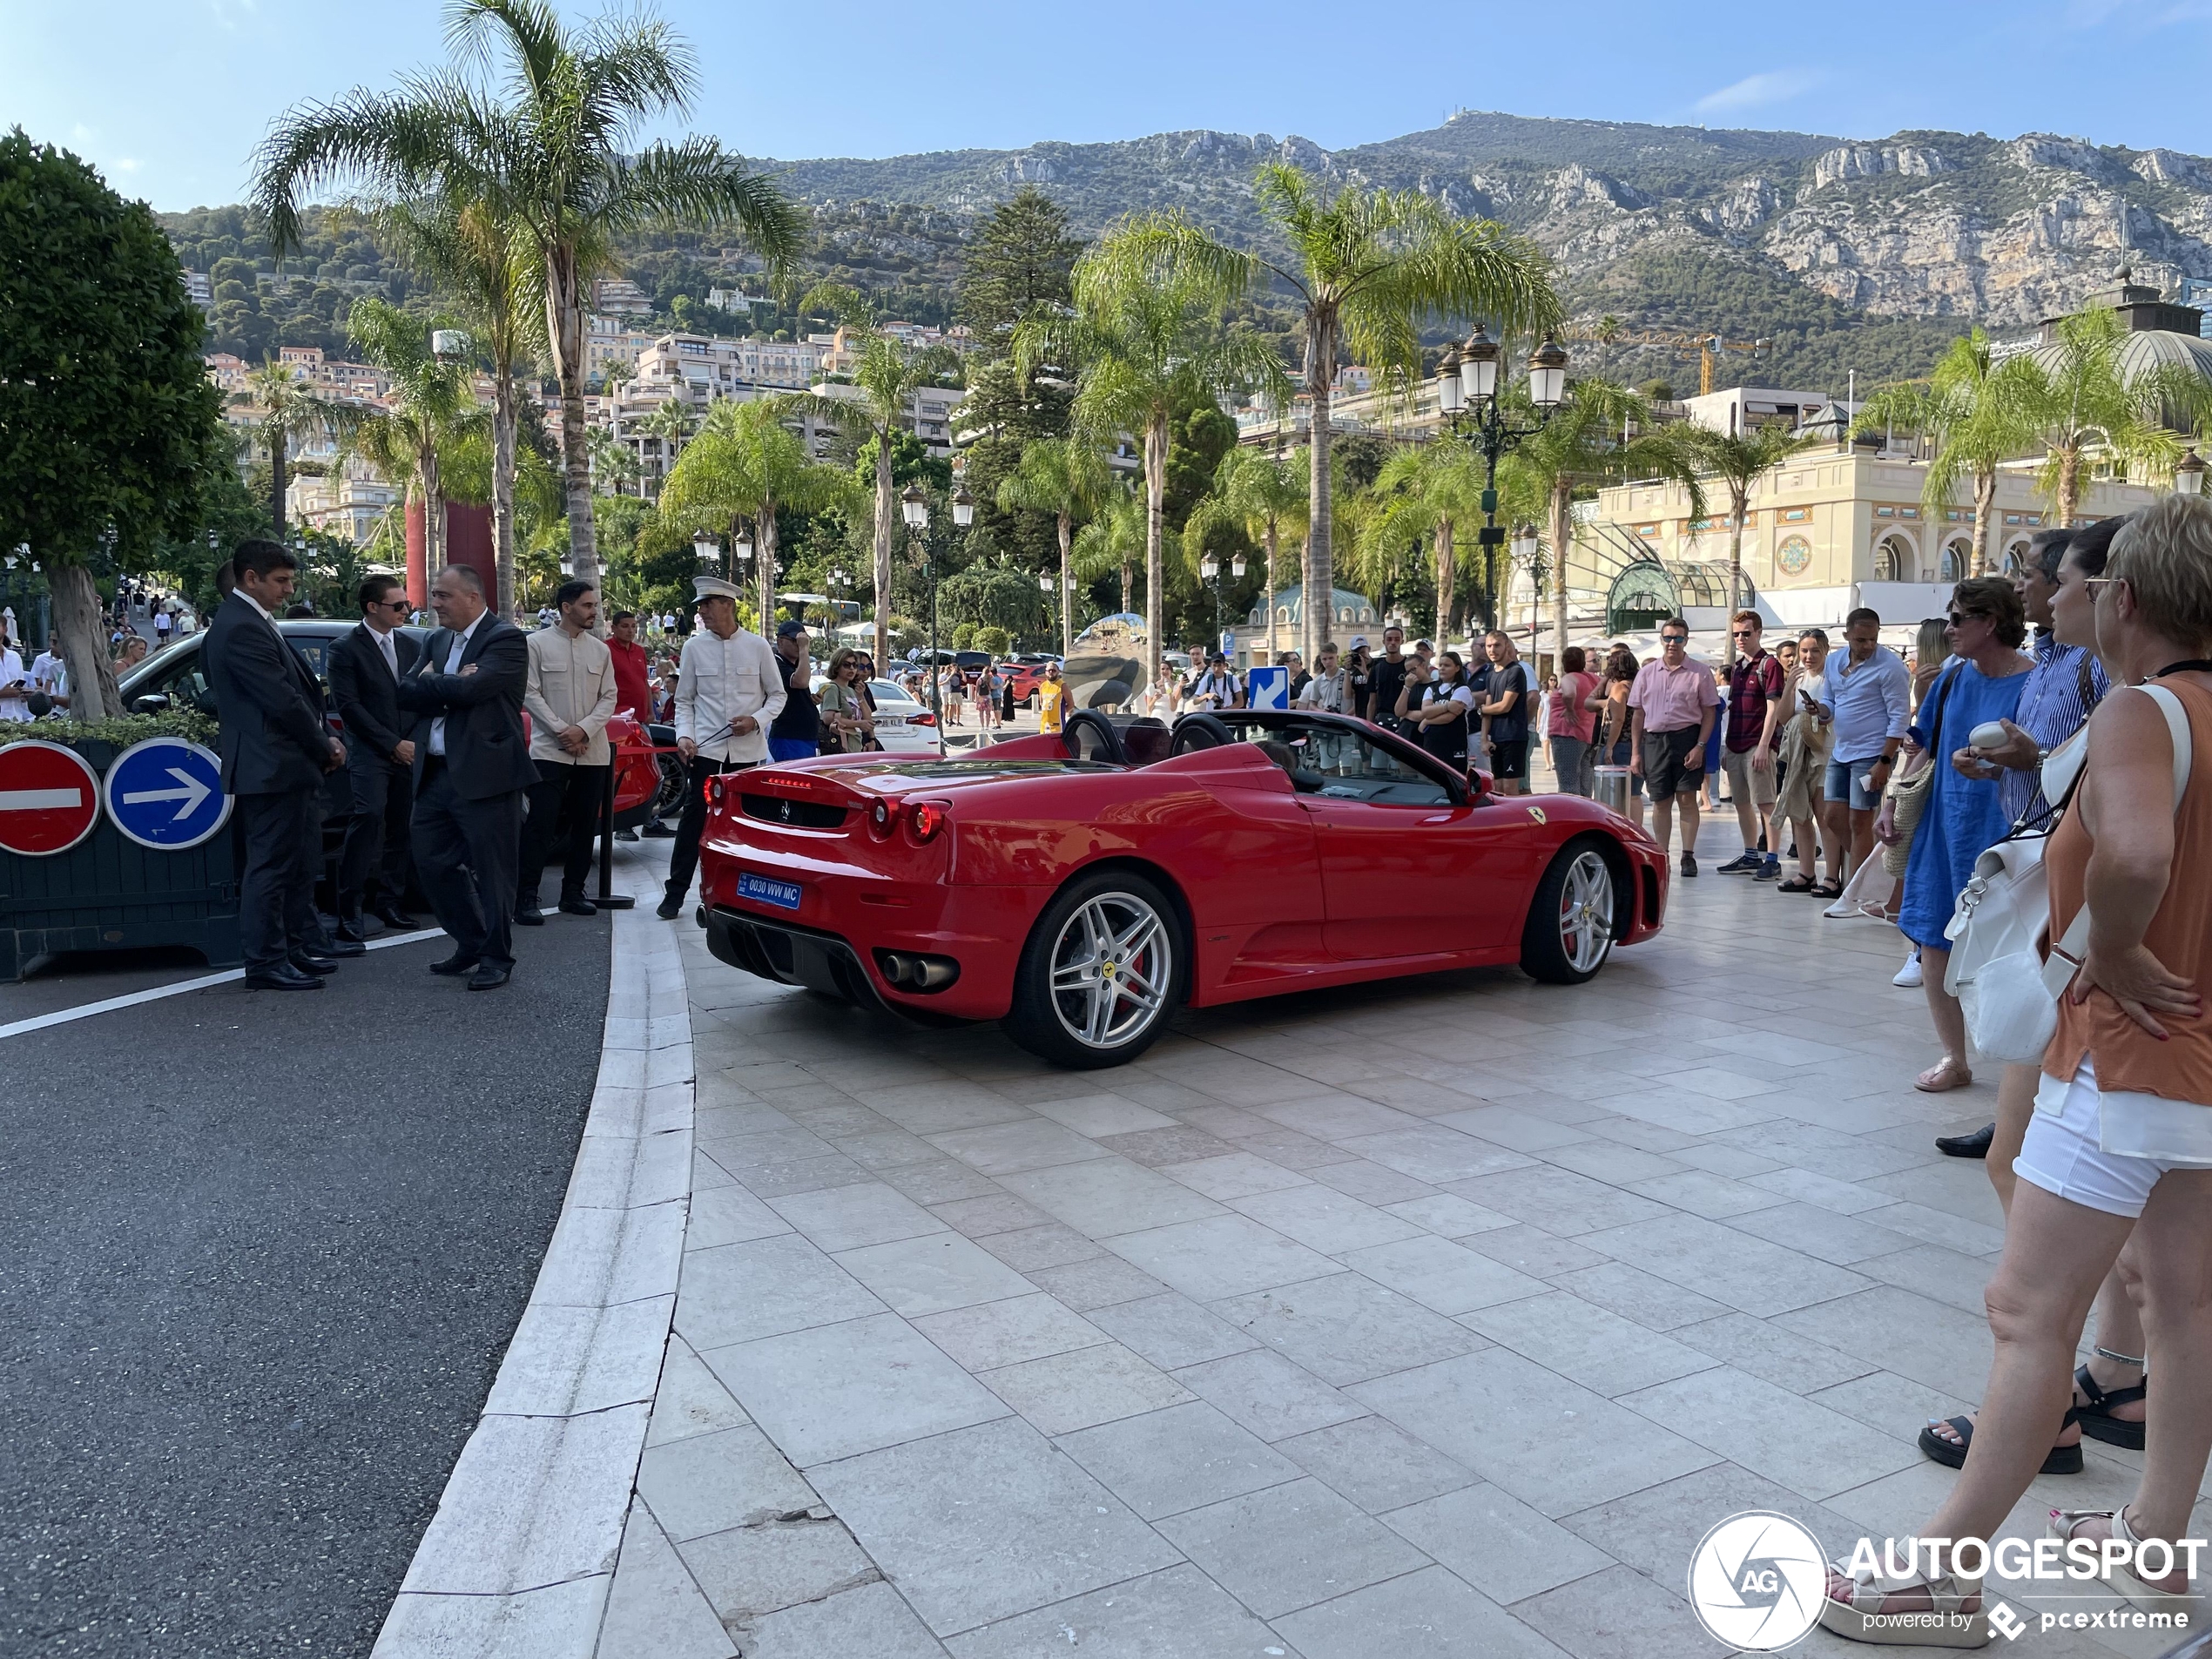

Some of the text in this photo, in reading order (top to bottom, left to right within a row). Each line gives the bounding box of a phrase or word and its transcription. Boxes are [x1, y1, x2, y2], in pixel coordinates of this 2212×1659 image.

[750, 879, 766, 894] 0030
[767, 883, 783, 897] WW
[783, 887, 797, 900] MC
